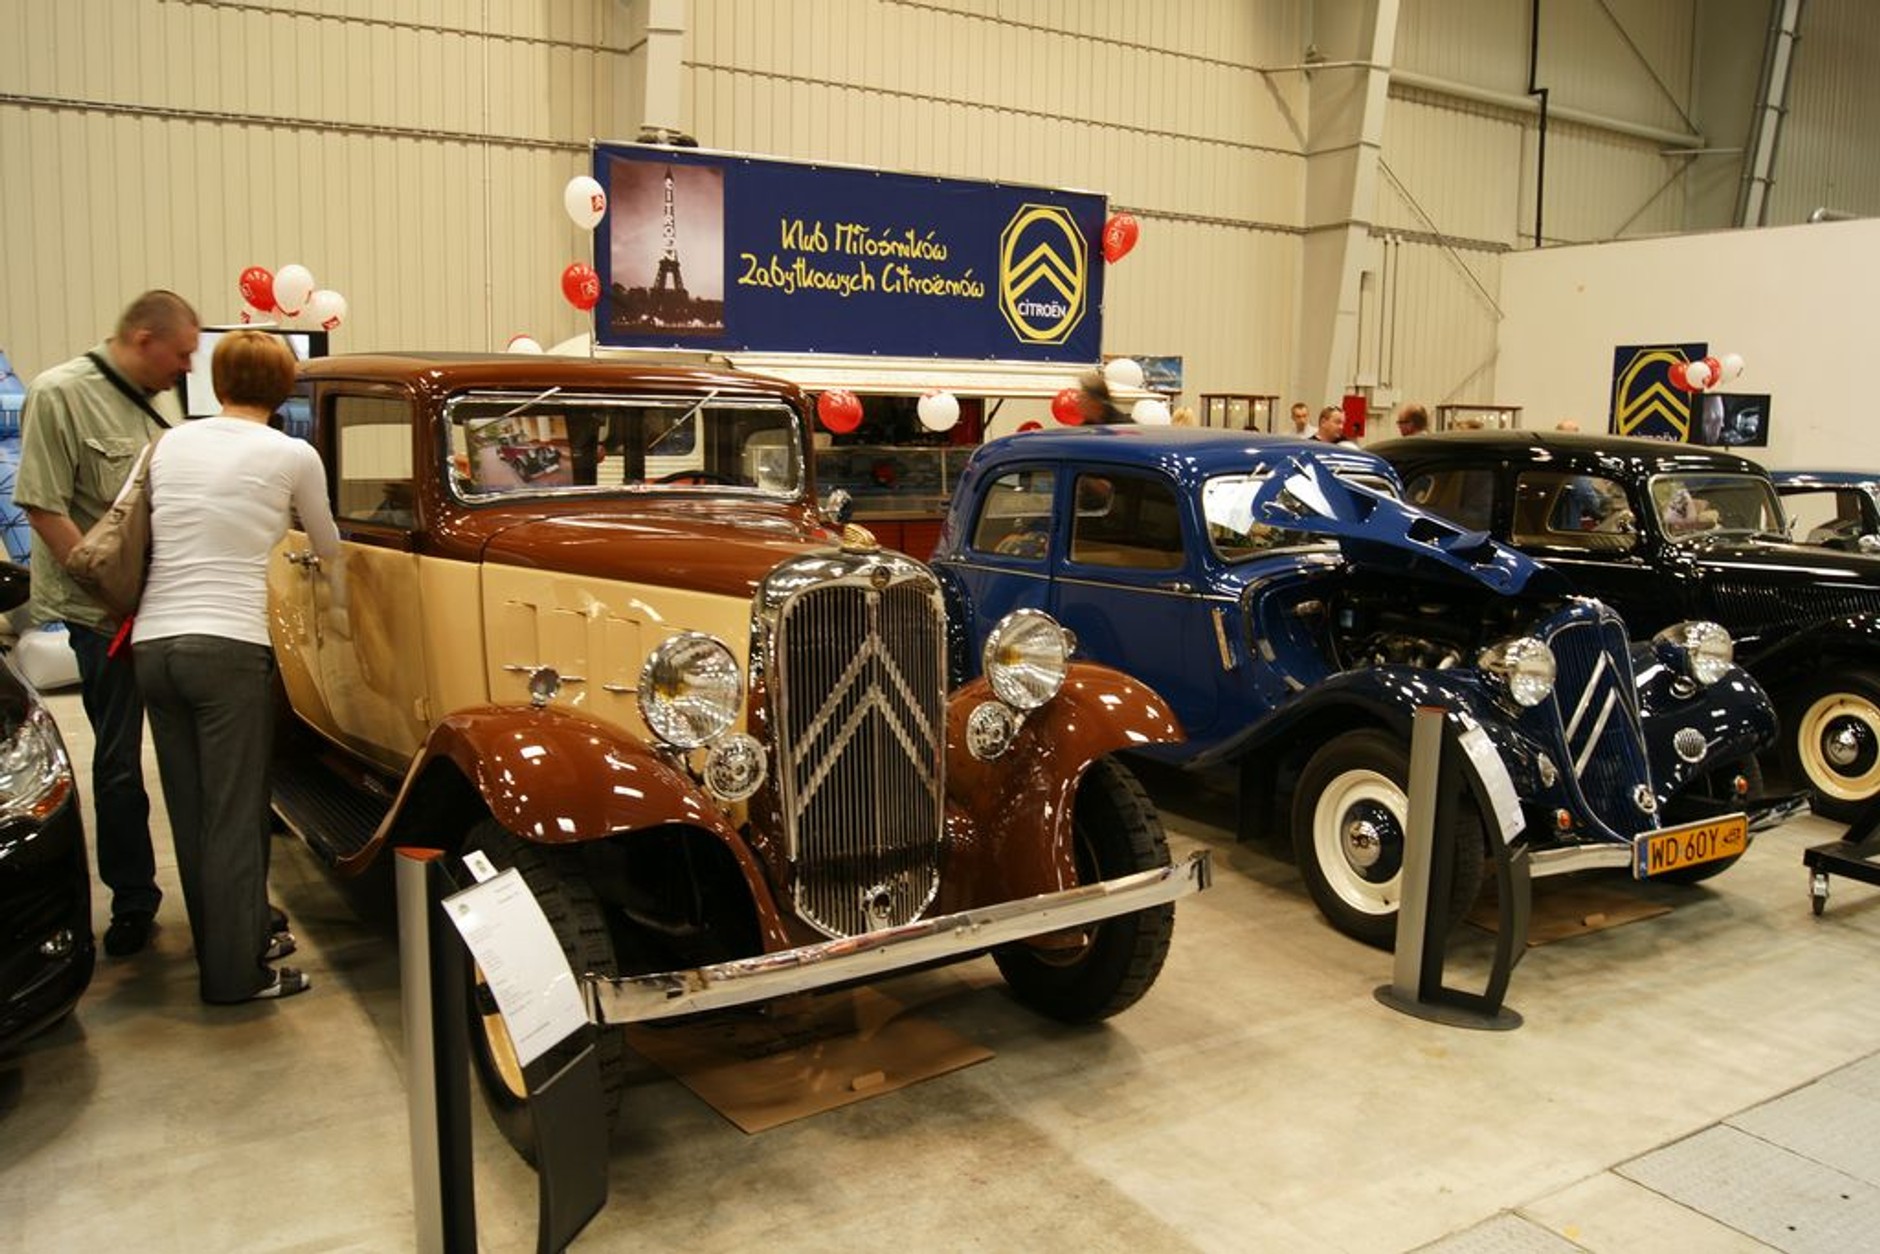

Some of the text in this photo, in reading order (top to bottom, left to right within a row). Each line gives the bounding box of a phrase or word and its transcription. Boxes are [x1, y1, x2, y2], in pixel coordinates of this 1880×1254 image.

[781, 218, 948, 261] Klub Miłośników
[738, 252, 985, 298] Zabytkowych Citroënów
[1652, 837, 1678, 870] WD
[1685, 828, 1720, 861] 60Y
